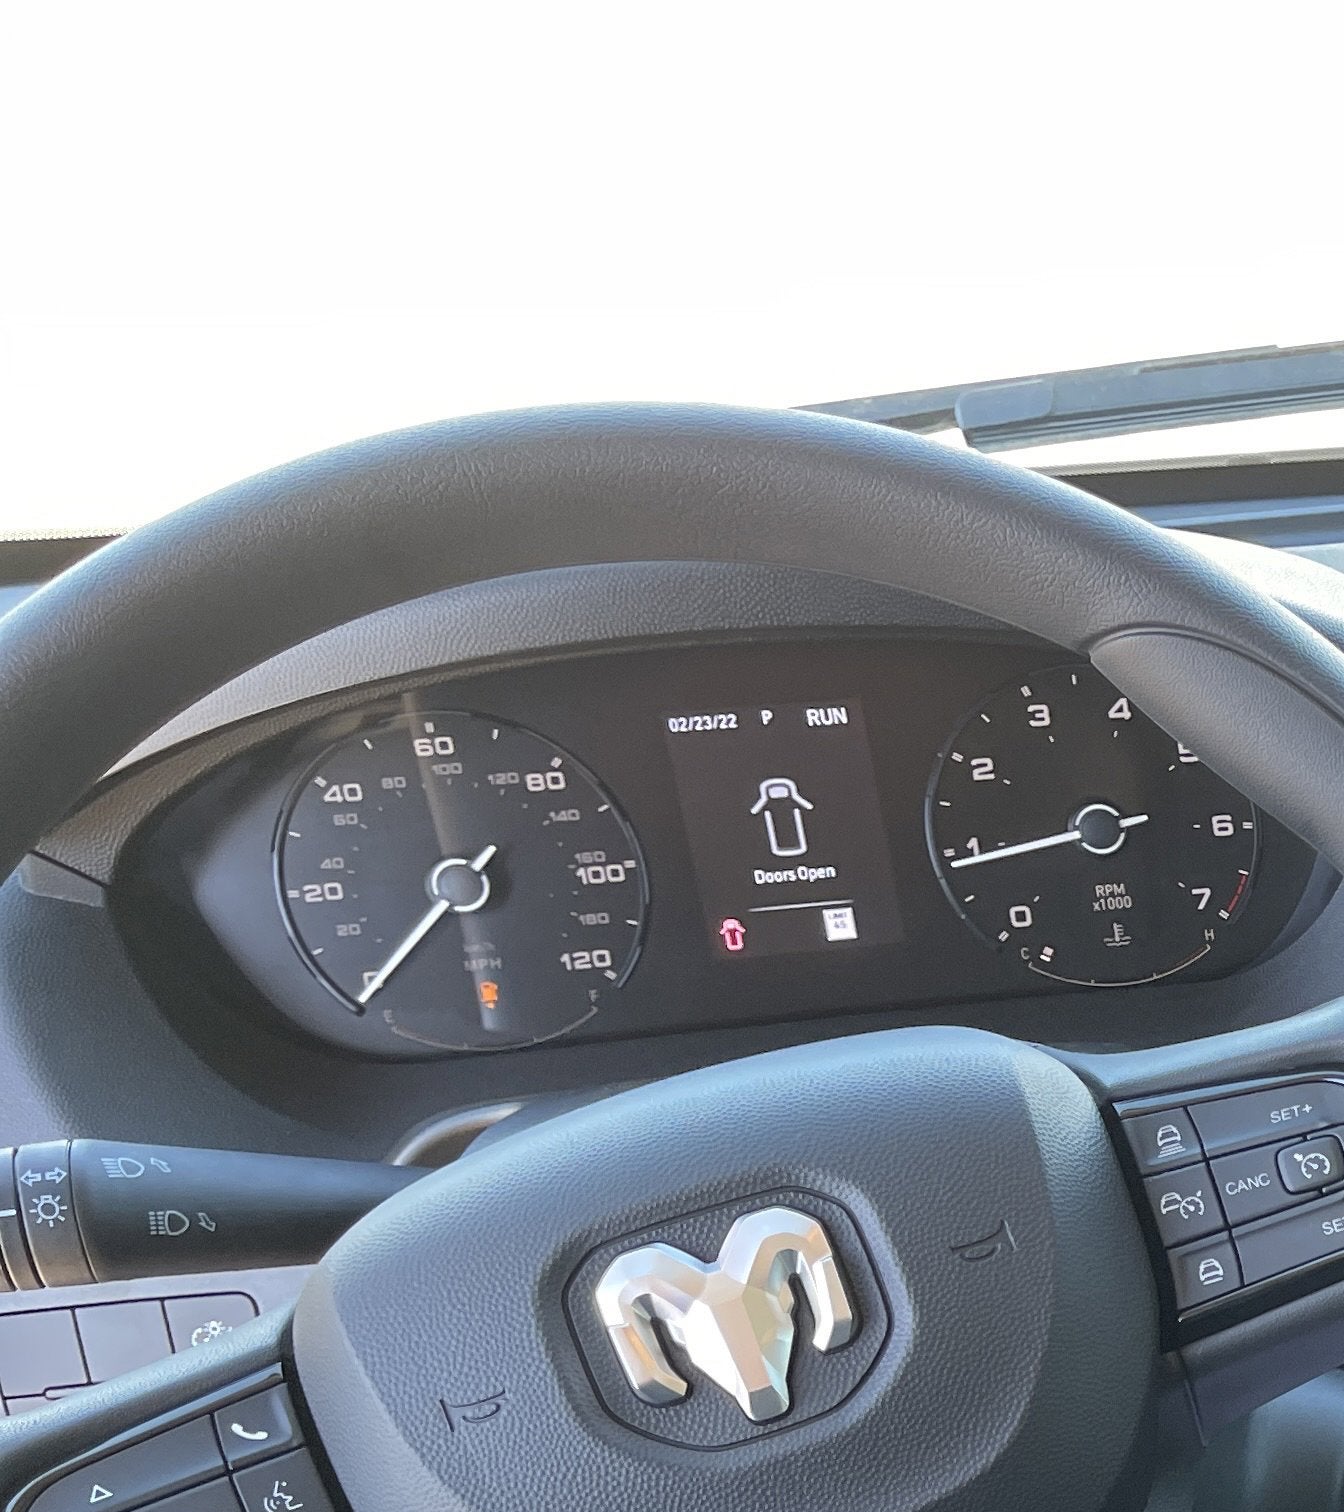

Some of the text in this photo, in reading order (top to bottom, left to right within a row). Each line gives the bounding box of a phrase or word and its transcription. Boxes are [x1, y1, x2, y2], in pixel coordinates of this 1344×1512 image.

[760, 709, 773, 726] P
[806, 707, 849, 727] RUN
[1026, 704, 1051, 728] 3
[1107, 698, 1132, 721] 4
[668, 713, 739, 733] 02/23/22
[413, 736, 455, 757] 60
[432, 762, 463, 775] 100
[487, 771, 520, 785] 120
[969, 757, 996, 781] 2
[381, 776, 407, 790] 80
[525, 771, 567, 792] 80
[323, 783, 364, 803] 40
[549, 808, 581, 822] 140
[1210, 815, 1235, 837] 6
[320, 857, 345, 869] 40
[575, 863, 626, 885] 100
[753, 865, 837, 885] Doors Open
[302, 882, 344, 903] 20
[1094, 883, 1127, 898] RPM
[1190, 887, 1212, 911] 7
[1092, 895, 1133, 911] x1000
[1008, 905, 1033, 928] 0
[336, 923, 363, 937] 20
[1204, 928, 1215, 941] H
[560, 949, 613, 971] 120
[1020, 947, 1030, 961] C
[463, 957, 503, 972] MPH
[1224, 1172, 1272, 1197] CANC
